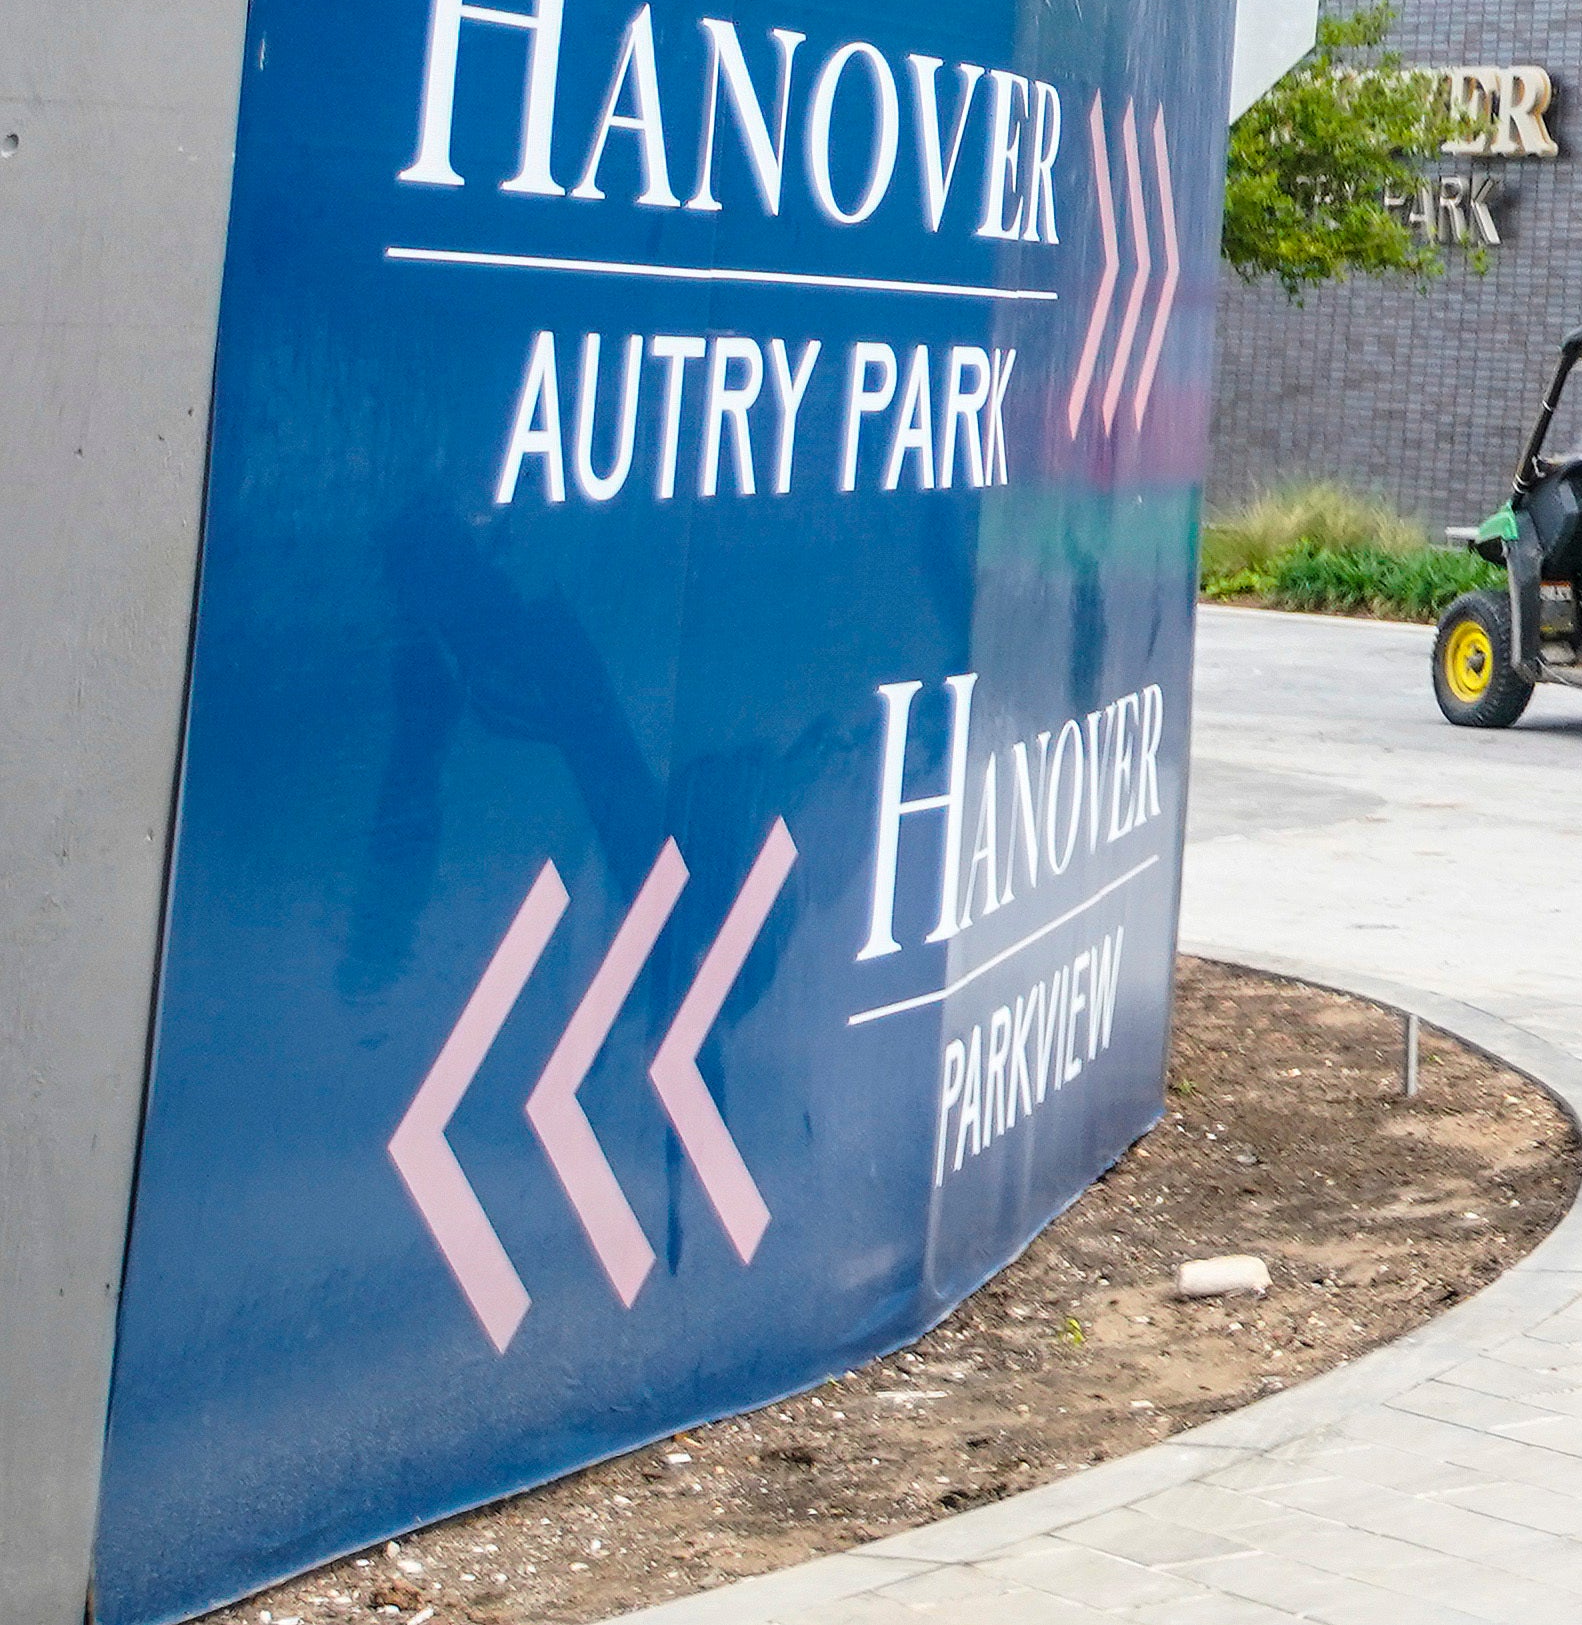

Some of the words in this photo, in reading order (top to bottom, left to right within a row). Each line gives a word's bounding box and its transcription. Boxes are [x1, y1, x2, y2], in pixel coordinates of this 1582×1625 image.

[495, 330, 822, 505] AUTRY
[839, 341, 1017, 494] PARK
[855, 672, 1164, 961] HANOVER
[935, 924, 1124, 1188] PARKVIEW
